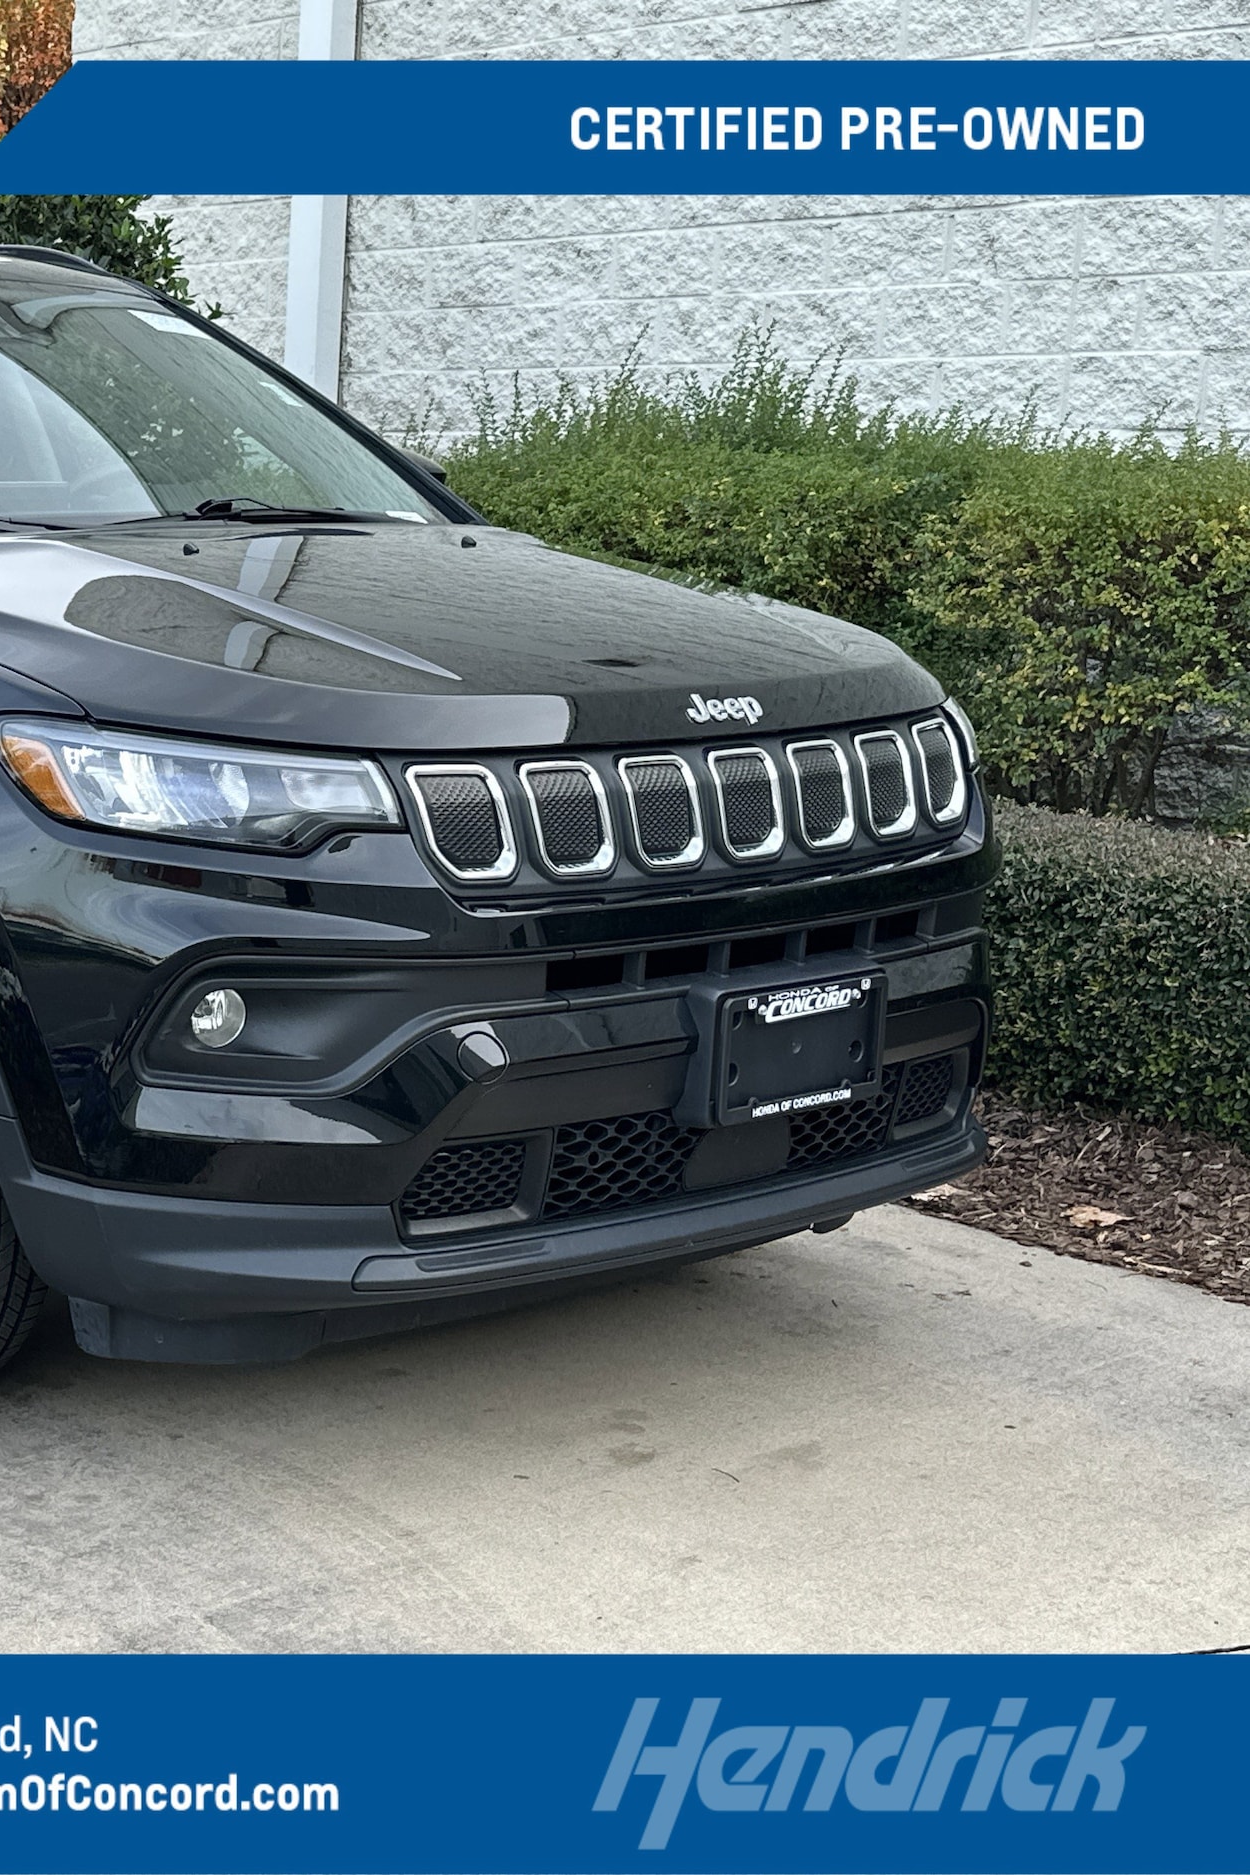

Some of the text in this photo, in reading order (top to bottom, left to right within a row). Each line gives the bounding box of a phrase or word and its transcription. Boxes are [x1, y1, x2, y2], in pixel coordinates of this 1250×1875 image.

[686, 693, 763, 725] Jeep
[765, 988, 851, 1023] CONCORD
[768, 984, 840, 1001] HONDA OF
[752, 1088, 852, 1118] HONDA OF CONCORD.COM
